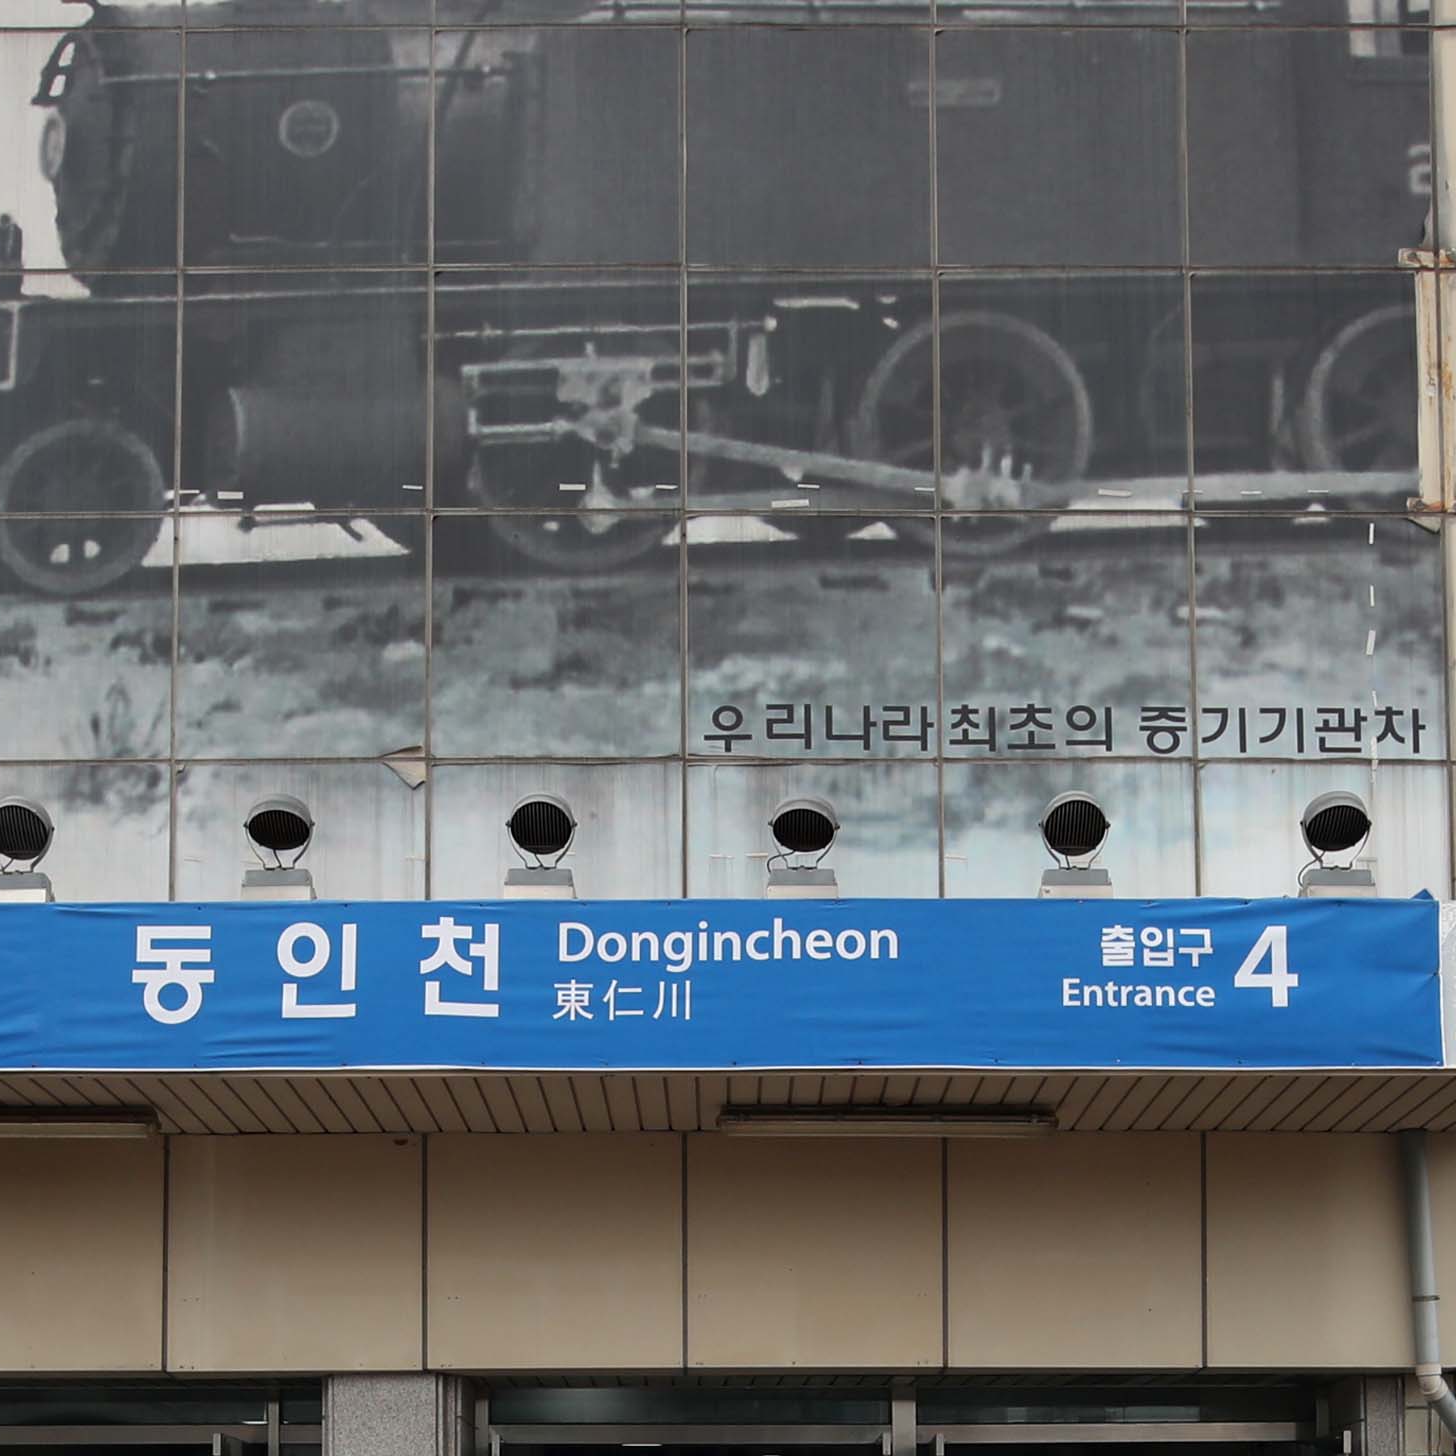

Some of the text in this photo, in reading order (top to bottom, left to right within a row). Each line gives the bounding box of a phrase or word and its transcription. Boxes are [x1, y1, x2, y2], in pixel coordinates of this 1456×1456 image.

[704, 703, 1426, 755] 우리나라 최초의 증기기관차
[557, 918, 899, 973] Dongincheon
[1062, 924, 1299, 1008] Entrance 4
[1100, 924, 1215, 968] 출입구
[552, 979, 693, 1022] 東仁川
